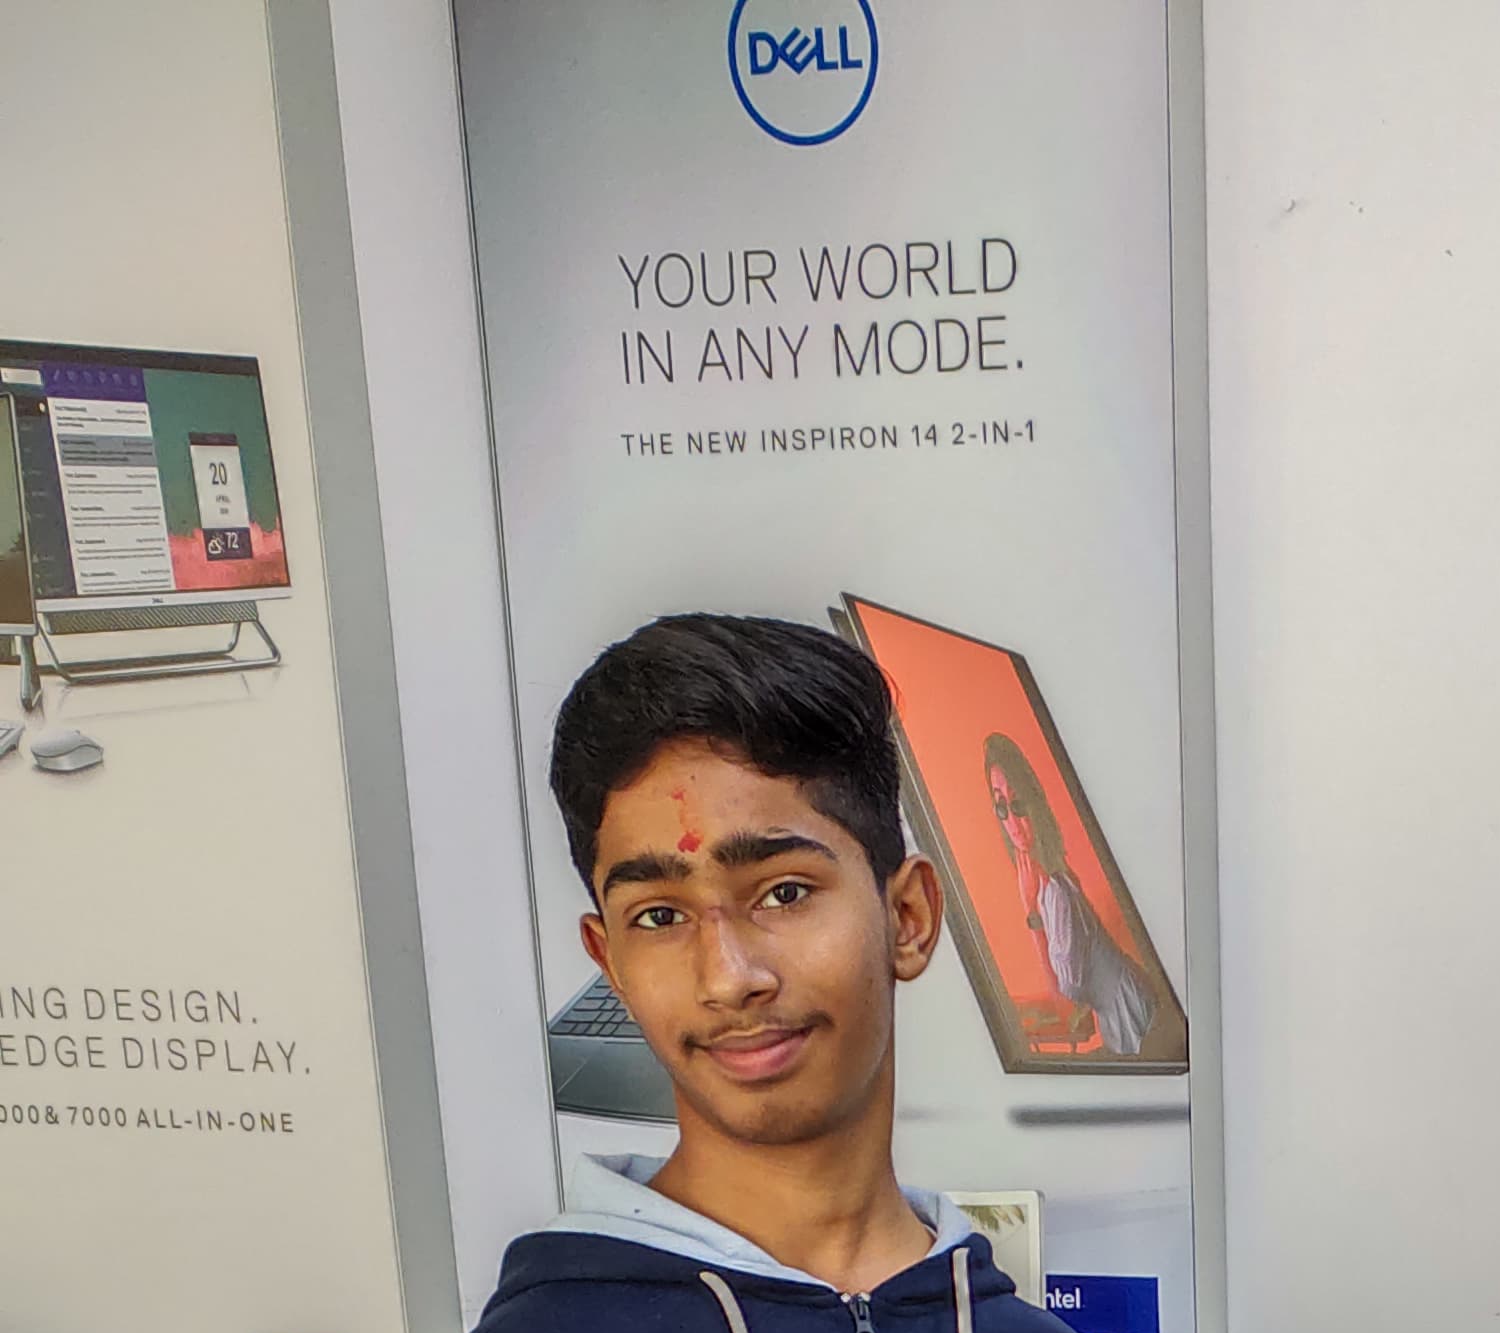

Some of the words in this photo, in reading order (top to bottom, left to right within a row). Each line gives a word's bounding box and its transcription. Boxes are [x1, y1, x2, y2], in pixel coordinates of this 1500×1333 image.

[748, 26, 863, 75] DELL
[618, 250, 777, 309] YOUR
[800, 238, 1018, 301] WORLD
[622, 330, 674, 384] IN
[698, 325, 808, 382] ANY
[834, 315, 1024, 378] MODE.
[621, 432, 674, 456] THE
[687, 430, 747, 454] NEW
[761, 425, 897, 452] INSPIRON
[911, 423, 937, 447] 14
[951, 420, 1036, 446] 2-IN-1
[209, 462, 228, 486] 20
[225, 532, 239, 549] 72
[83, 988, 258, 1024] DESIGN.
[0, 1034, 106, 1068] EDGE
[122, 1037, 311, 1075] DISPLAY.
[66, 1106, 127, 1128] 7000
[136, 1108, 294, 1133] ALL-IN-ONE
[1045, 1287, 1080, 1309] ntel
